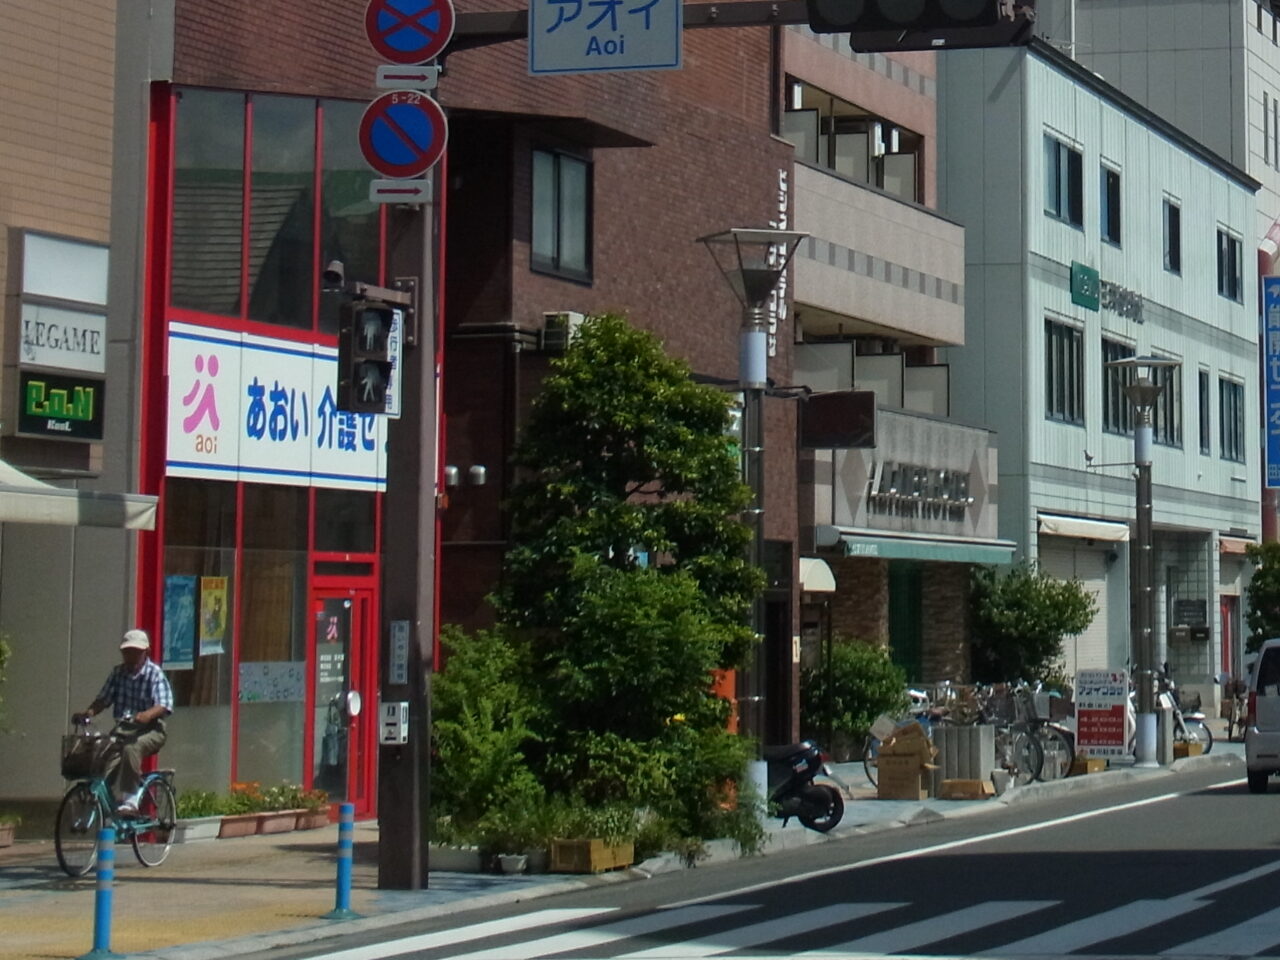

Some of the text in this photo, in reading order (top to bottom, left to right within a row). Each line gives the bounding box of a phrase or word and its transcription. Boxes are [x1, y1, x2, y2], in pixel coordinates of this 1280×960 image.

[585, 34, 626, 57] Aoi
[391, 92, 422, 105] 5-22
[23, 320, 101, 355] LEGAME
[246, 376, 309, 442] あおい
[195, 433, 218, 454] aoi
